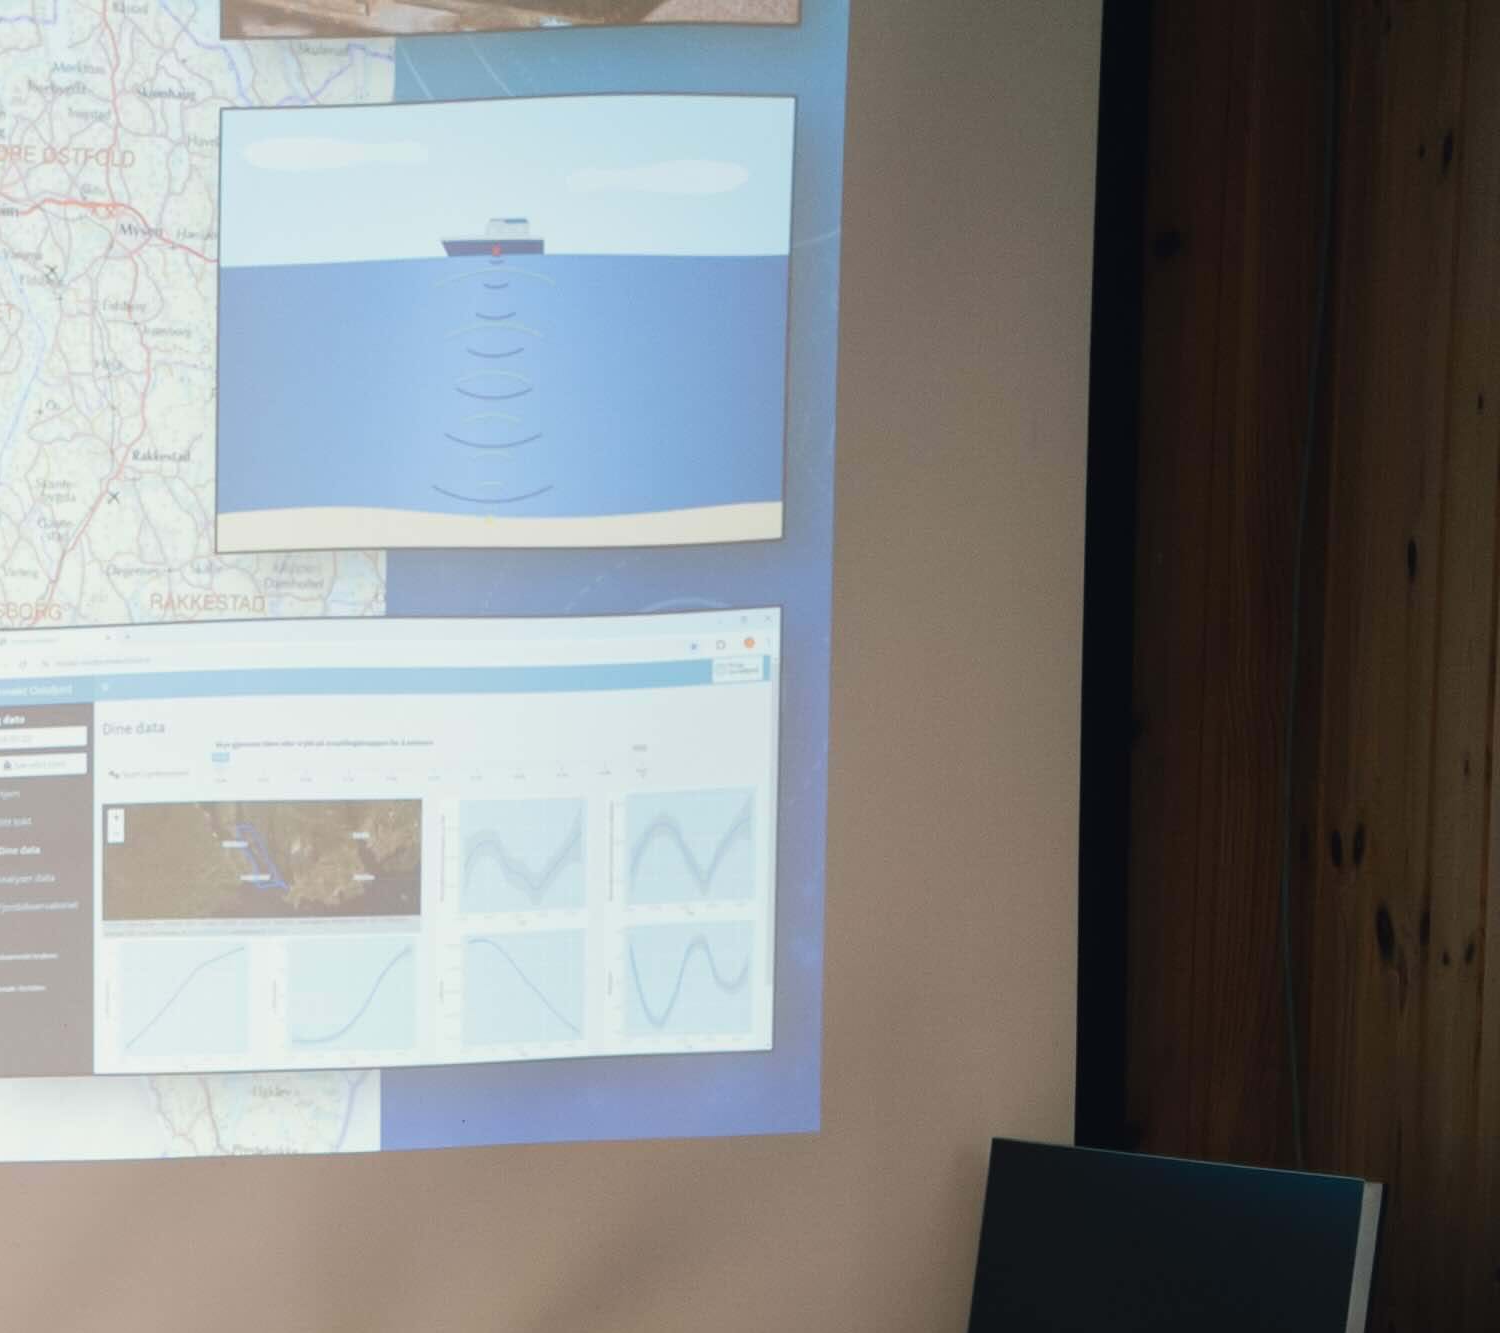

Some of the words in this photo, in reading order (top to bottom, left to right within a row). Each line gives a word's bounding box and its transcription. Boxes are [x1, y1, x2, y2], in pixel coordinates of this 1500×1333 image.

[149, 591, 266, 613] RAKKESTAD
[102, 721, 133, 736] Dine
[136, 720, 166, 734] data
